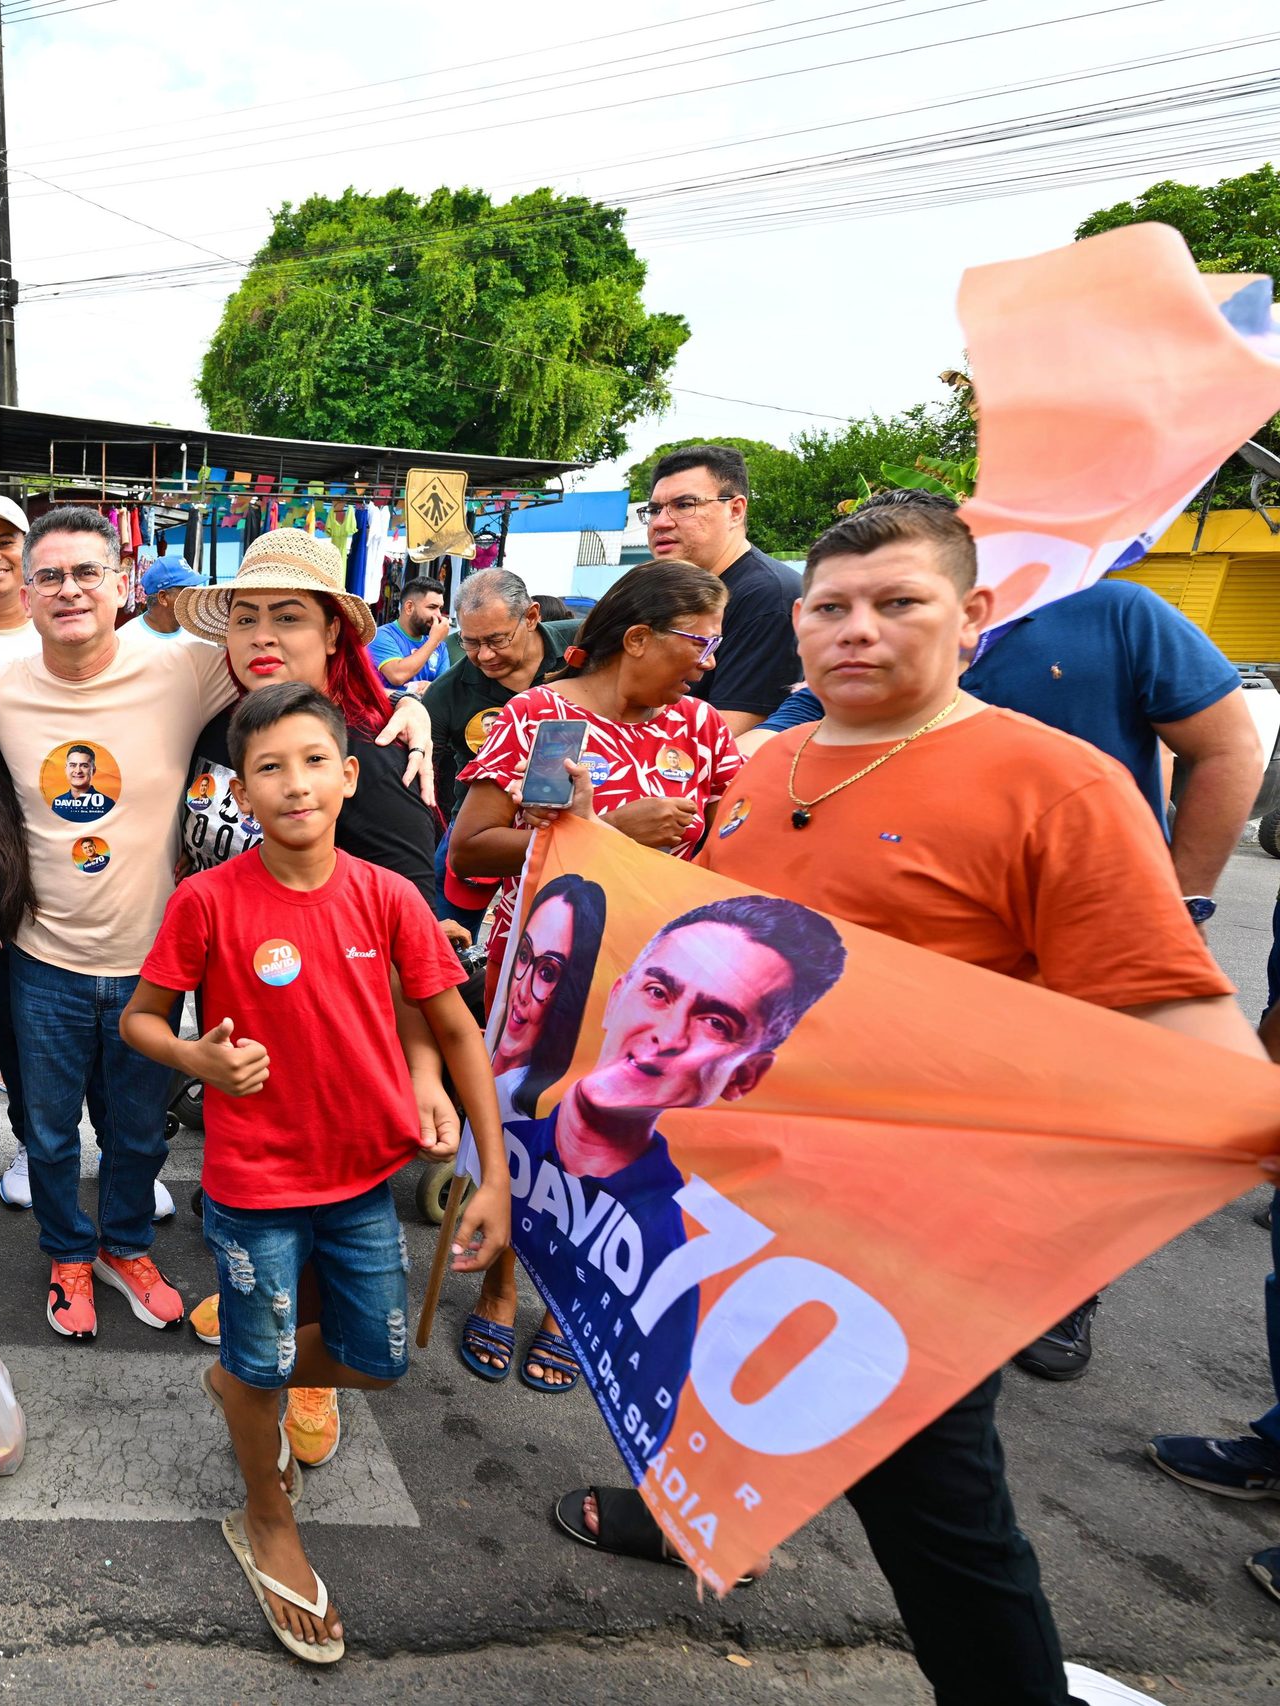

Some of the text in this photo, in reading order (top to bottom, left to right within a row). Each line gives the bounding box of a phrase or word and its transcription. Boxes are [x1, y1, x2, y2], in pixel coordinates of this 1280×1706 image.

[54, 793, 105, 807] DAVID 70
[94, 855, 105, 865] 70
[268, 945, 293, 962] 70
[261, 957, 296, 974] DAVID
[503, 1126, 644, 1297] DAVID
[630, 1173, 909, 1456] 70
[571, 1298, 600, 1352] VICE
[597, 1349, 622, 1411] Dra.
[623, 1403, 718, 1551] SHÁDIA
